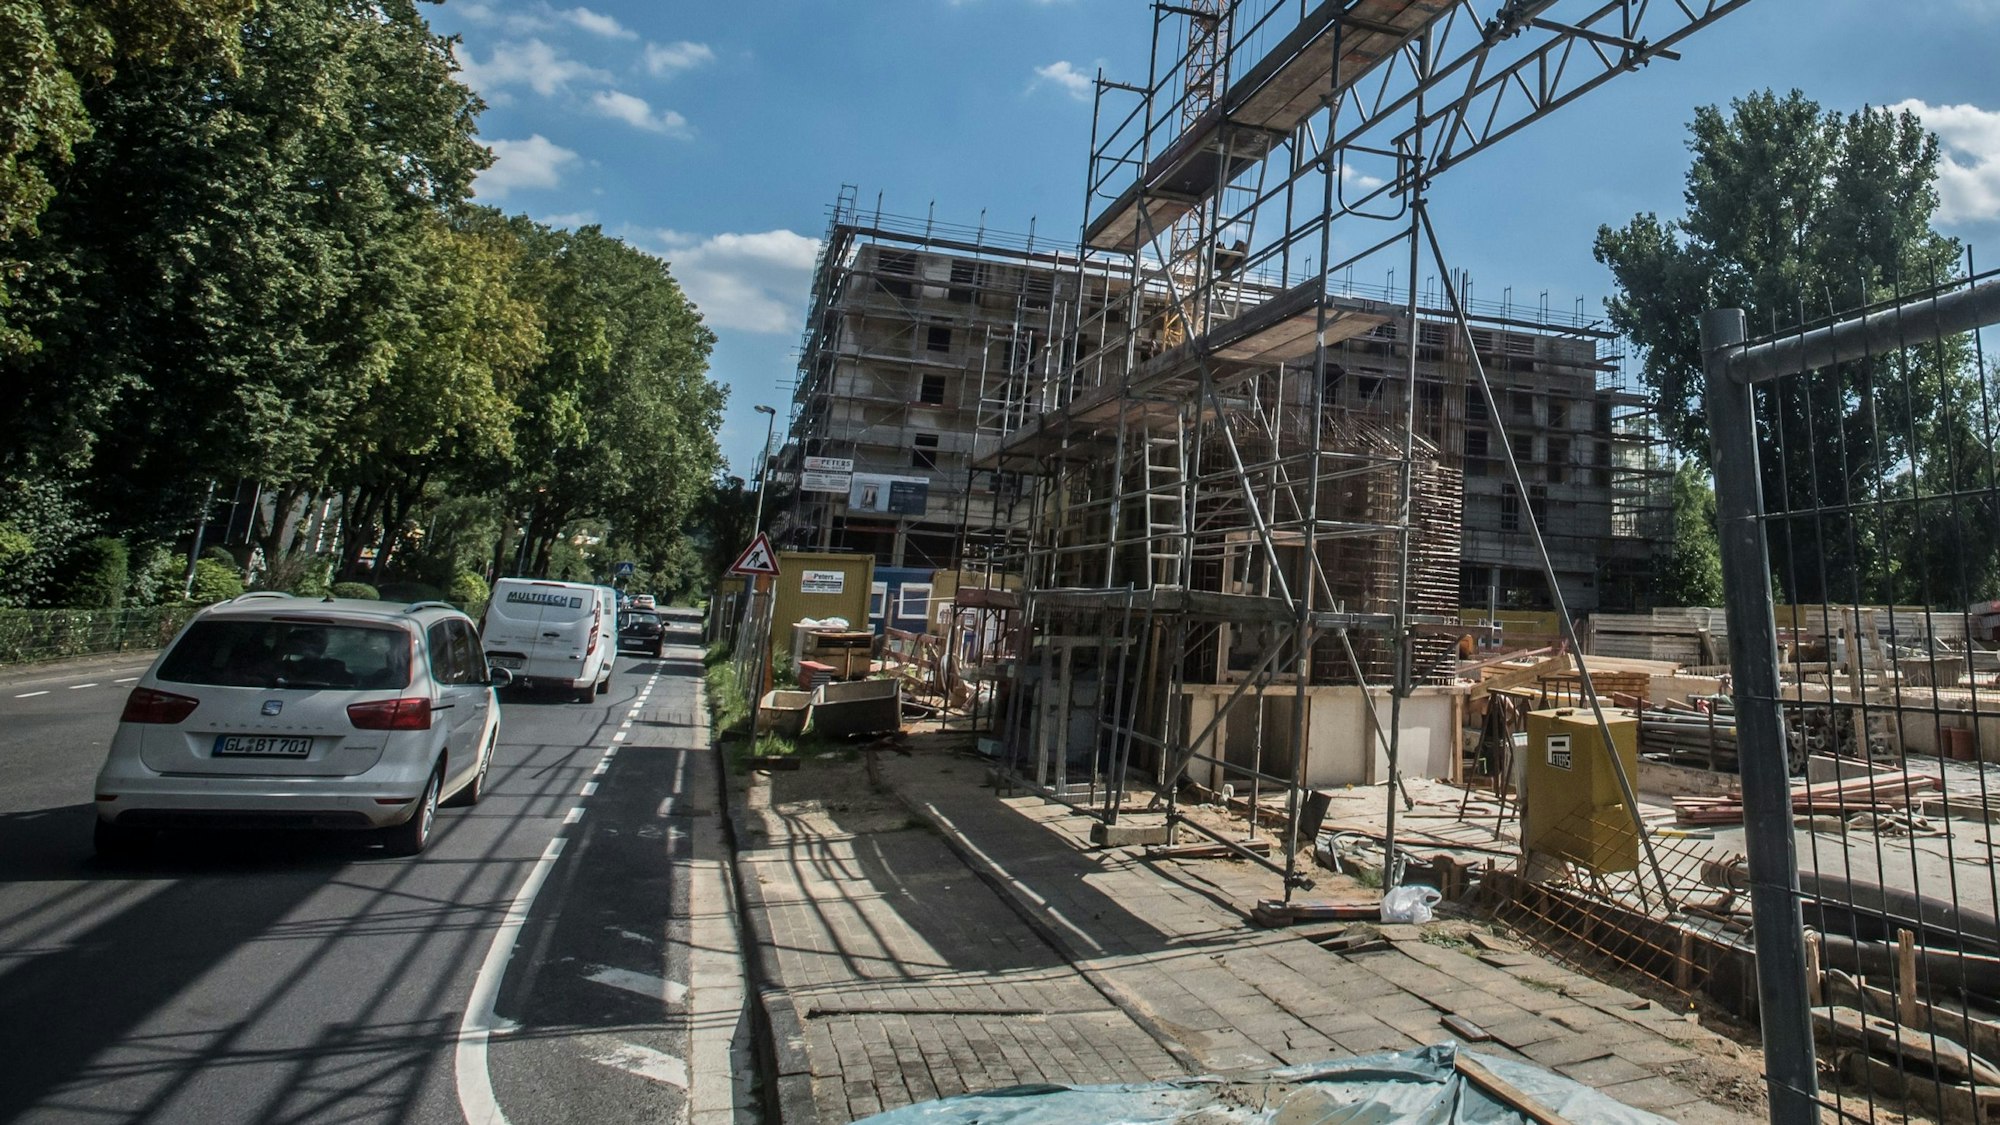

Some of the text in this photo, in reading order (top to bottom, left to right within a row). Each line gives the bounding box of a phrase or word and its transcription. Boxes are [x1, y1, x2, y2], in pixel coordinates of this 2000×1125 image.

[507, 591, 568, 604] MULTITECH
[225, 738, 307, 753] GL BT 701
